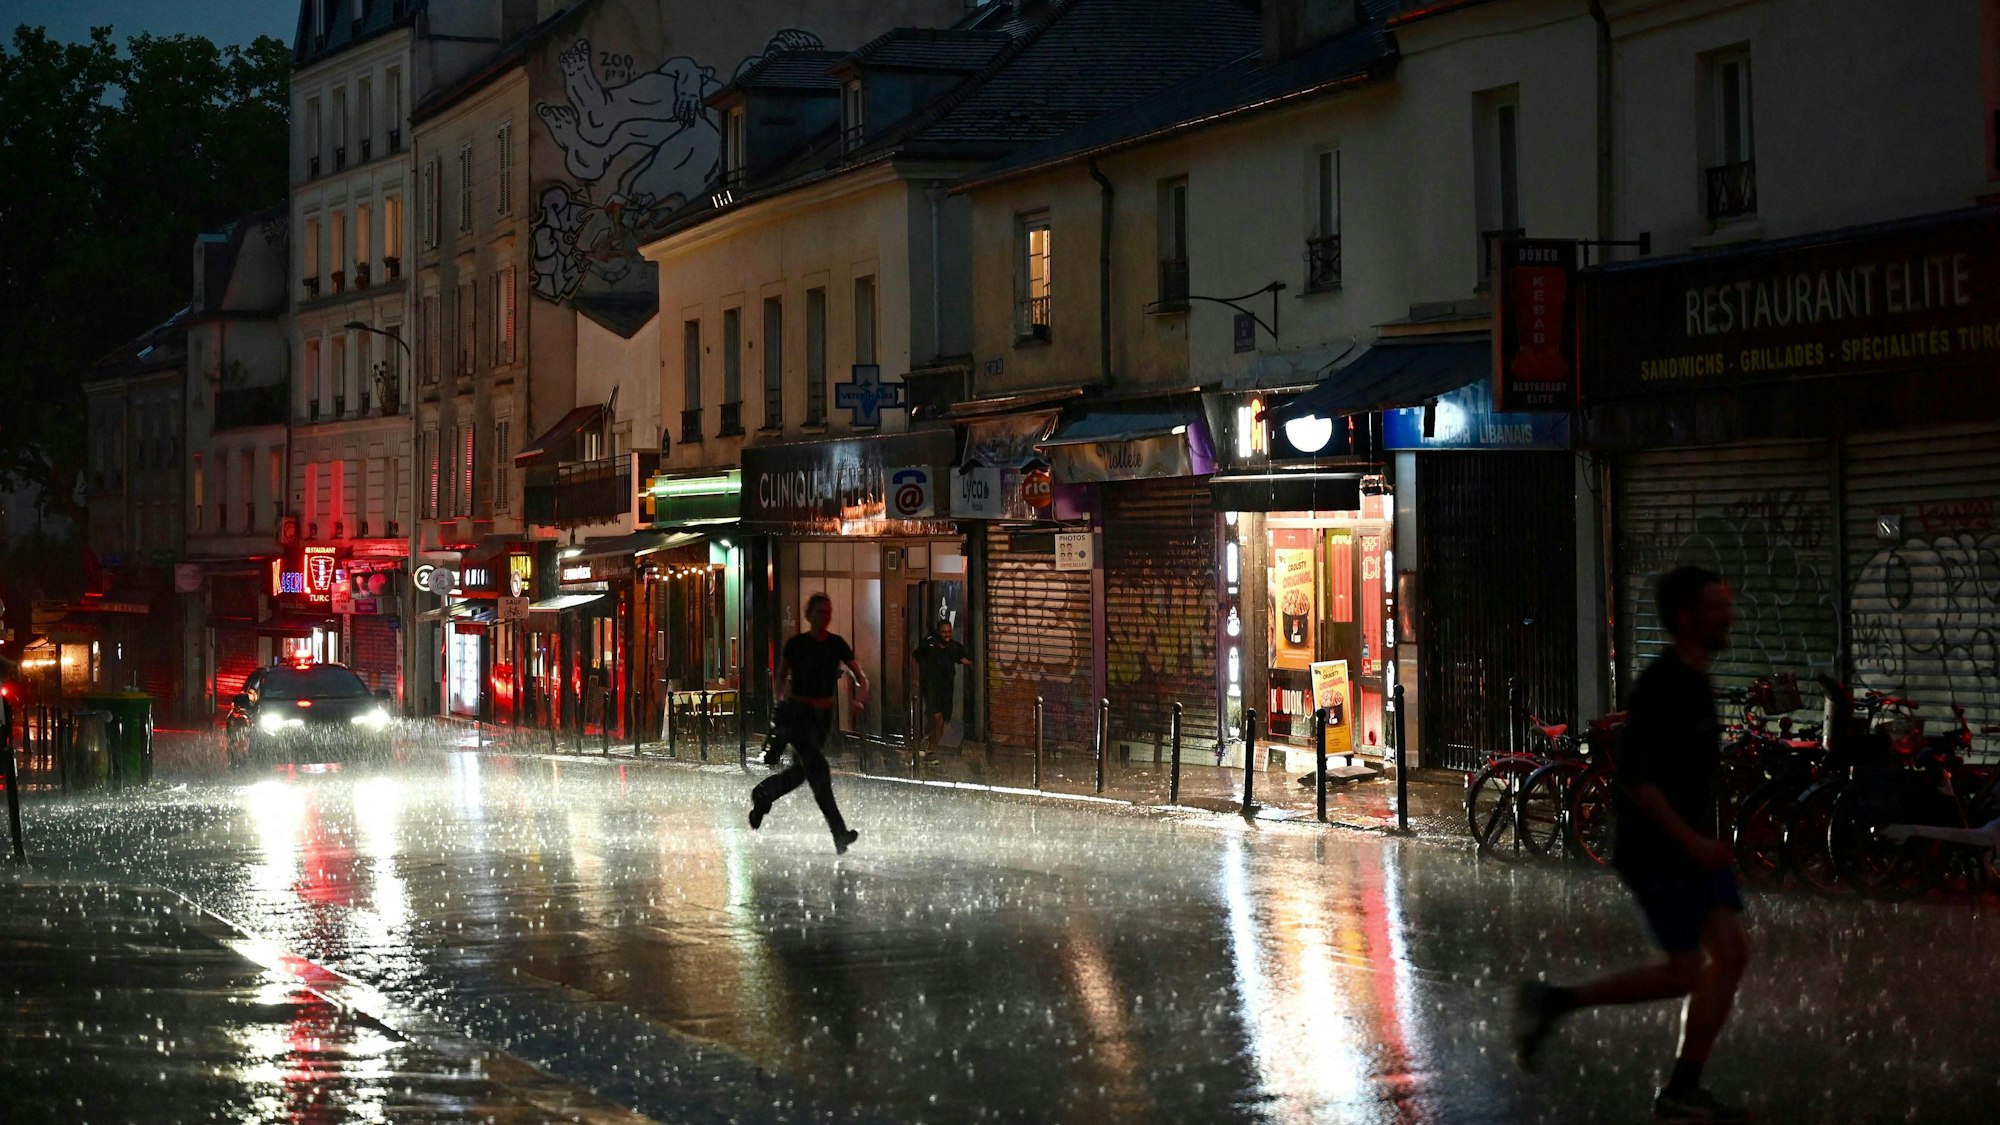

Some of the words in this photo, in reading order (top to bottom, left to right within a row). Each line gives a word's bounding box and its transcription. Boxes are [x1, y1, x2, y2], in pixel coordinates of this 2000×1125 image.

[600, 52, 634, 69] ZOO
[1685, 262, 1877, 338] RESTAURANT
[1885, 252, 1973, 313] ELITE
[1531, 274, 1546, 344] KEBAB
[1640, 352, 1725, 382] SANDWICHS
[1739, 342, 1825, 373] GRILLADES
[1841, 325, 1951, 363] SPÉCIALITÉS
[1512, 381, 1568, 394] RESTAURANT
[1526, 393, 1554, 405] ELITE
[1478, 423, 1533, 445] LIBANAIS
[759, 470, 824, 509] CLINIQUE
[962, 476, 983, 504] Lyca
[1024, 476, 1051, 496] ria
[1058, 534, 1086, 542] PHOTOS
[308, 594, 330, 602] TURC
